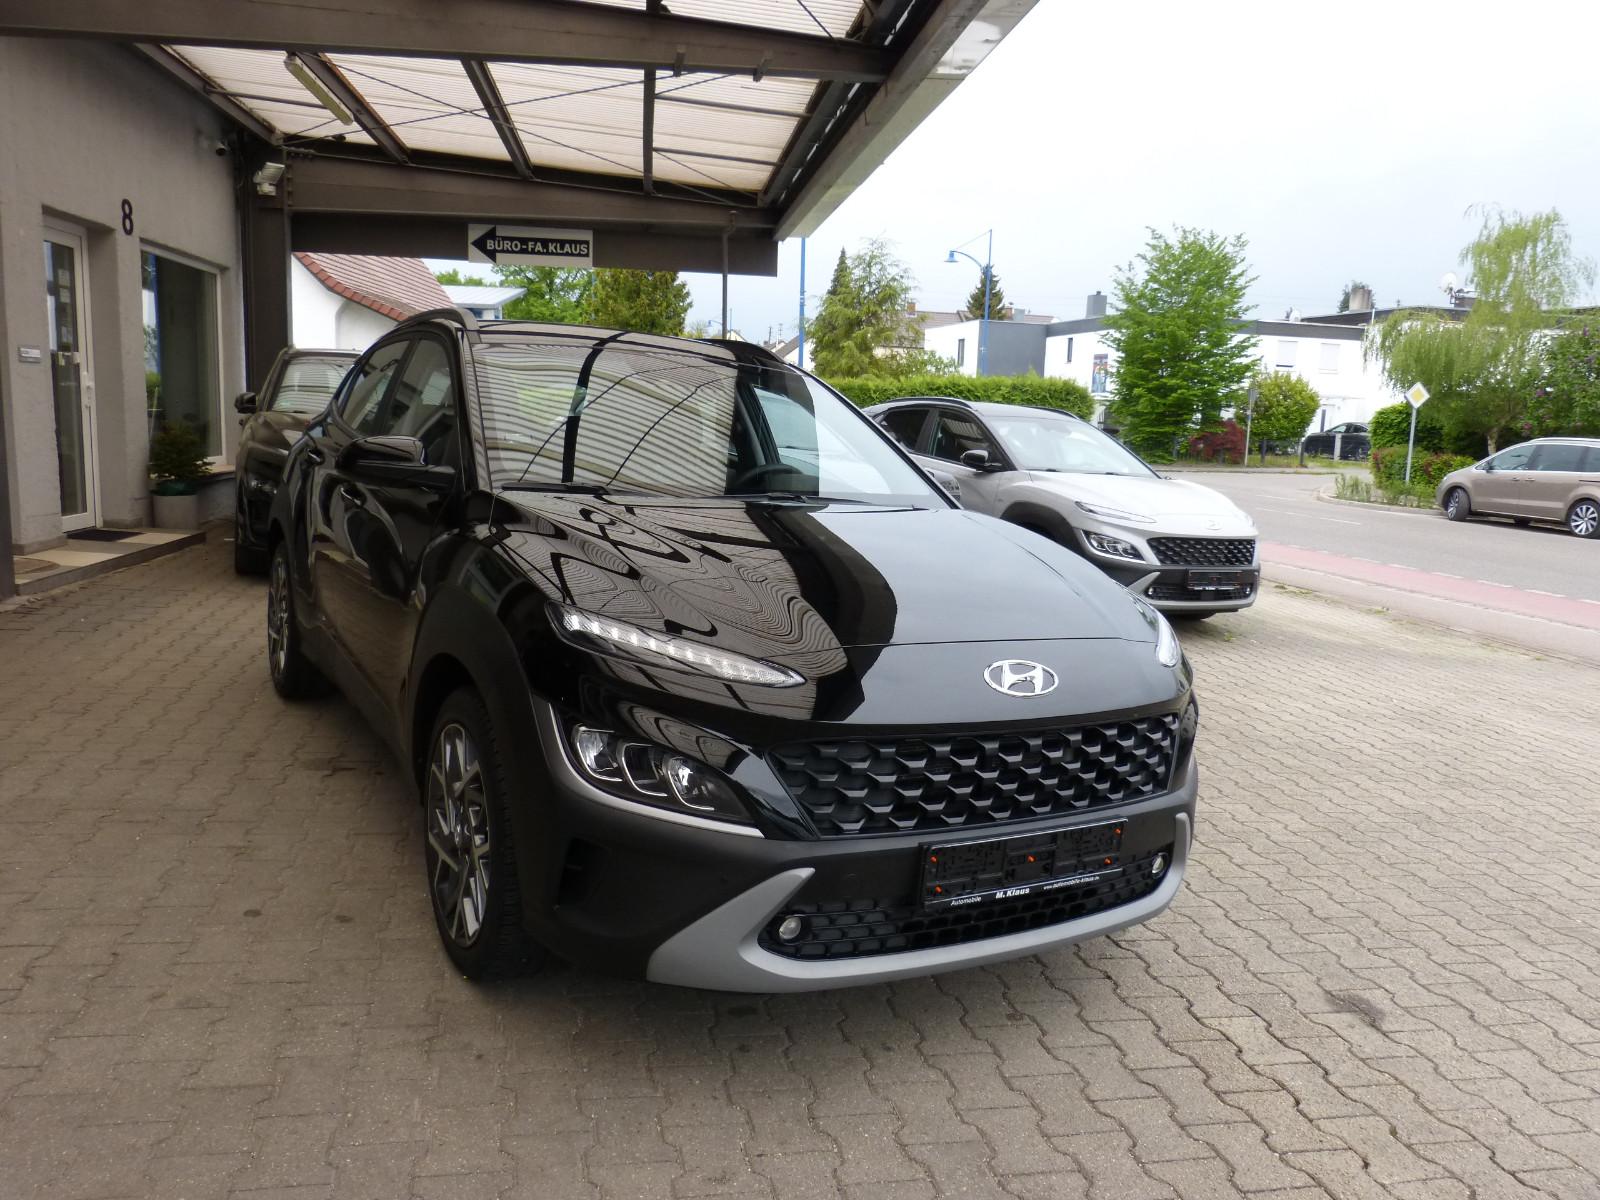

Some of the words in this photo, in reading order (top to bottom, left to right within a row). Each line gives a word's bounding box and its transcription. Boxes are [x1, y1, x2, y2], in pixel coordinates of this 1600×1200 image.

[121, 198, 134, 236] 8
[950, 895, 982, 906] Automobile
[995, 891, 1005, 899] M.
[1006, 887, 1030, 897] Klaus
